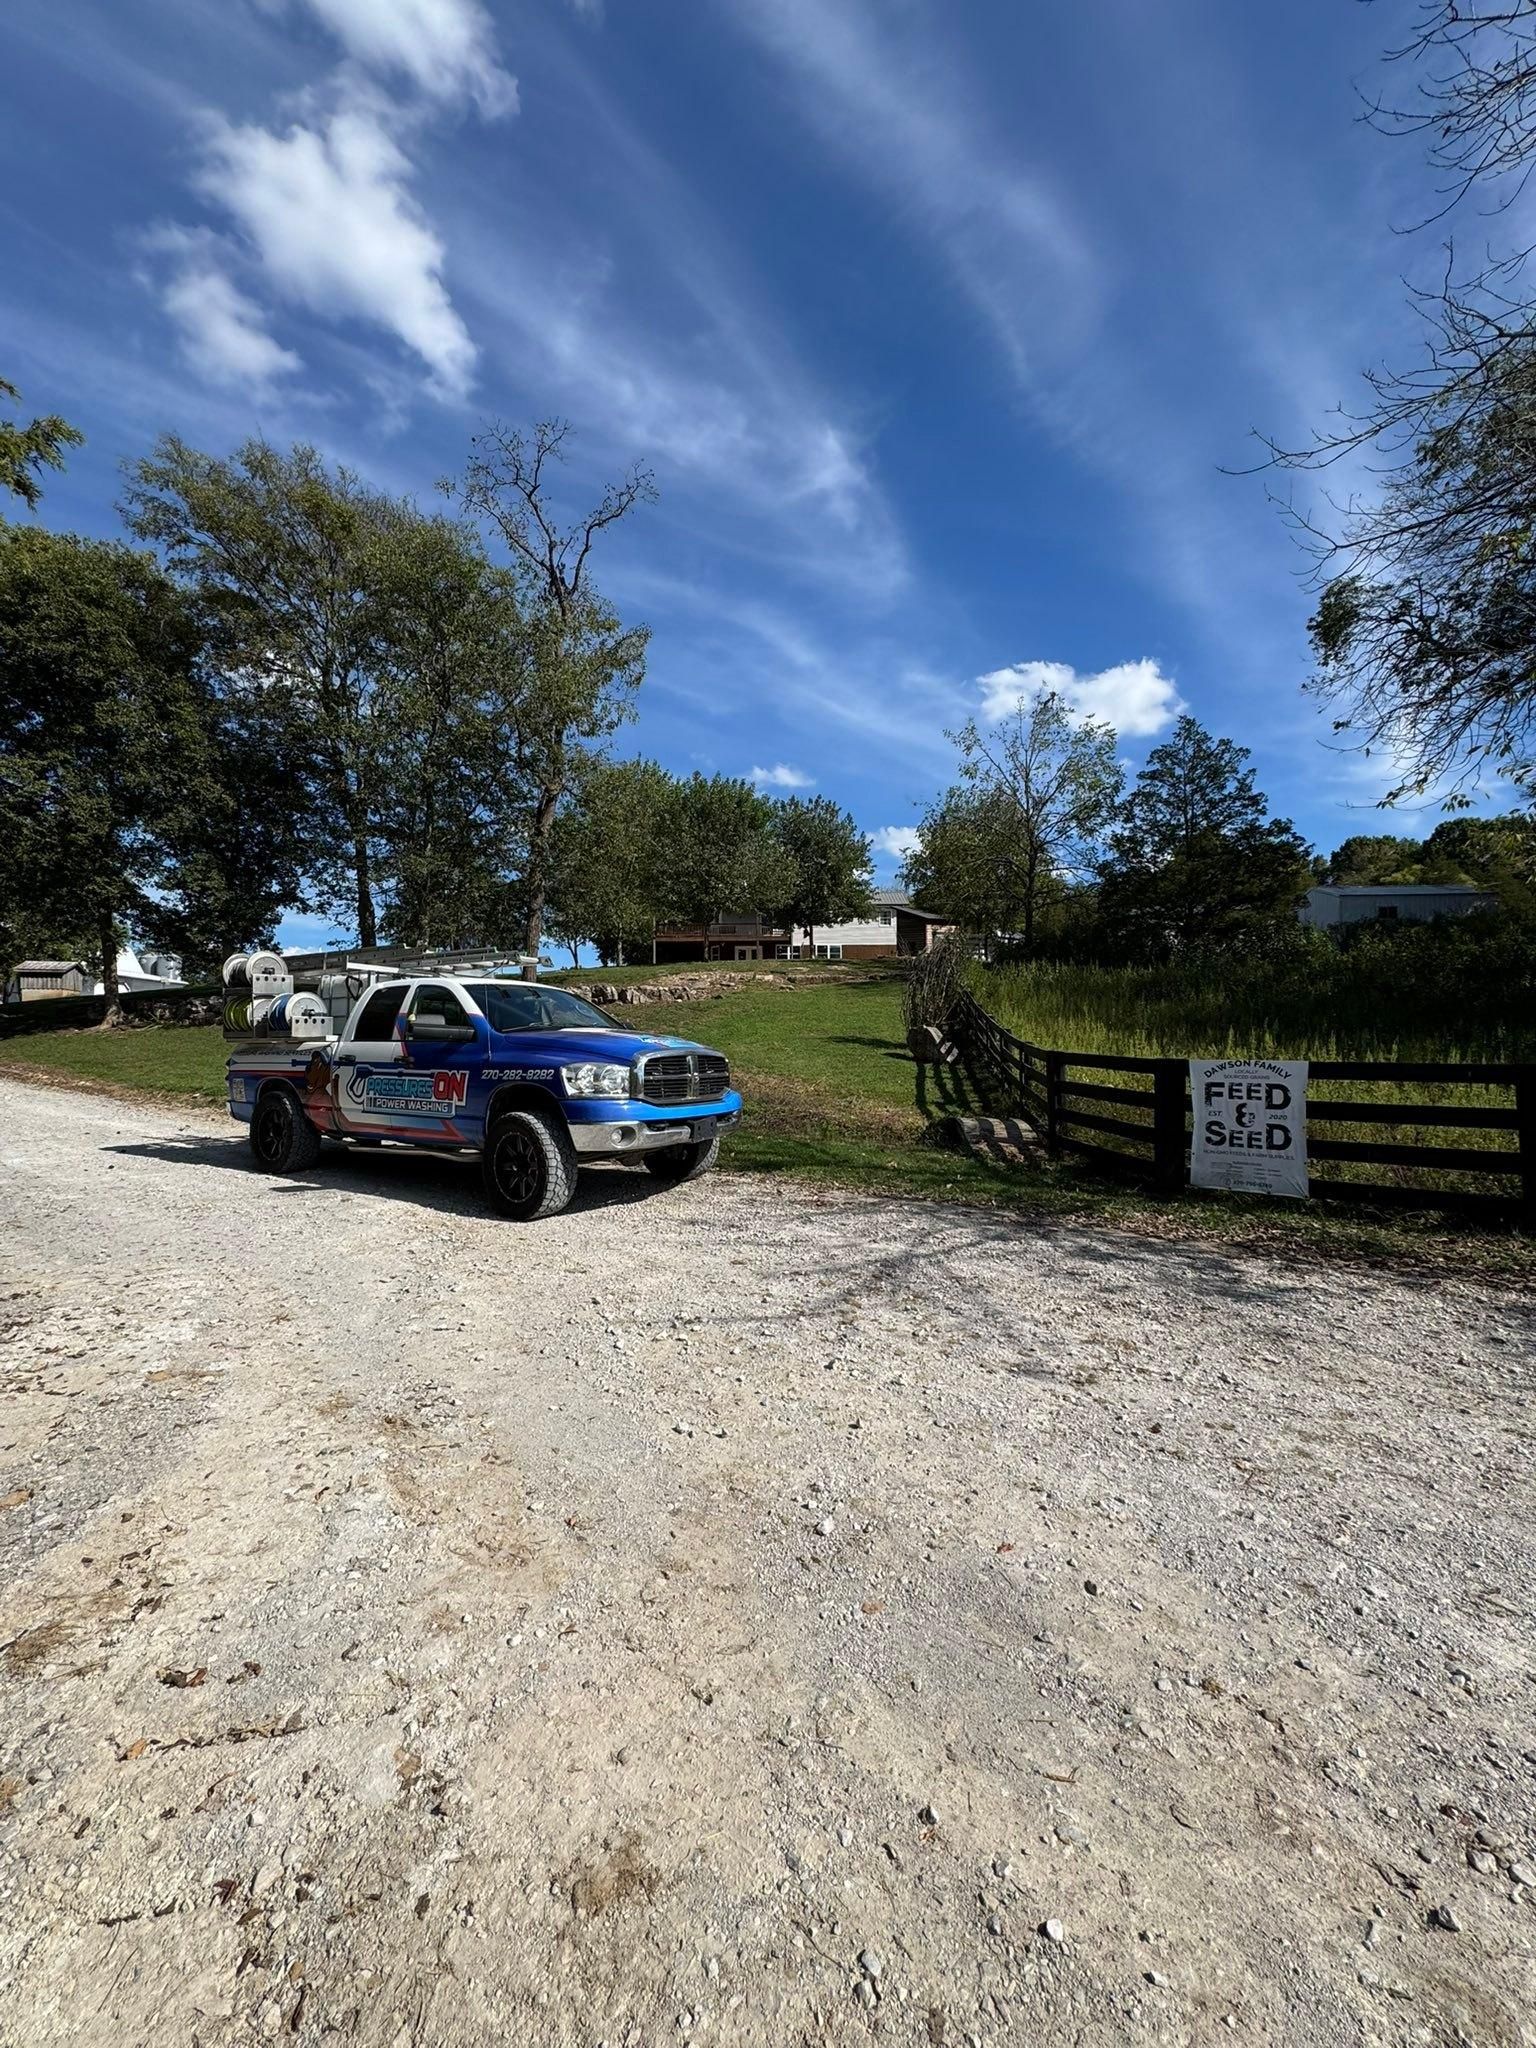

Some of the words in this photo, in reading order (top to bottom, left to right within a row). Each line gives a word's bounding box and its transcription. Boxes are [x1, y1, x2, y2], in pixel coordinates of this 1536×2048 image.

[481, 1068, 555, 1080] 270-282-8282
[1203, 1060, 1251, 1079] DAWSON
[1254, 1060, 1292, 1080] FAMILY
[433, 1071, 466, 1101] ON
[1204, 1081, 1292, 1110] FEED
[375, 1098, 406, 1110] POWER
[407, 1100, 449, 1113] WASHING
[1235, 1102, 1256, 1128] &
[1204, 1120, 1292, 1151] SEED
